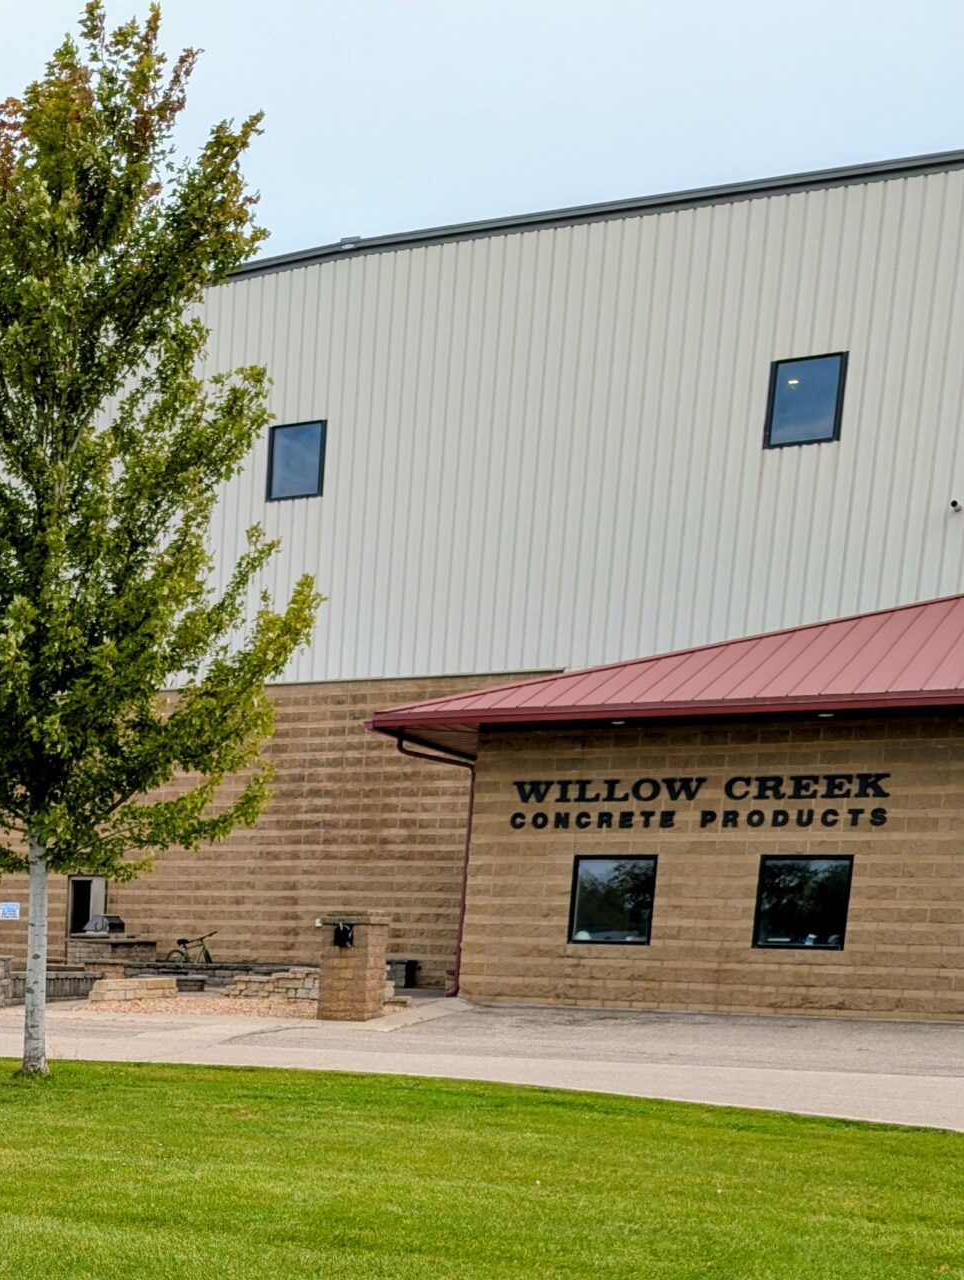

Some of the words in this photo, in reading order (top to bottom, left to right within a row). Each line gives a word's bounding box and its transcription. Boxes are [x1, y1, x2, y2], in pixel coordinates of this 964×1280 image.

[513, 777, 707, 803] WILLOW
[724, 773, 891, 800] CREEK
[510, 810, 676, 829] CONCRETE
[700, 808, 888, 828] PRODUCTS
